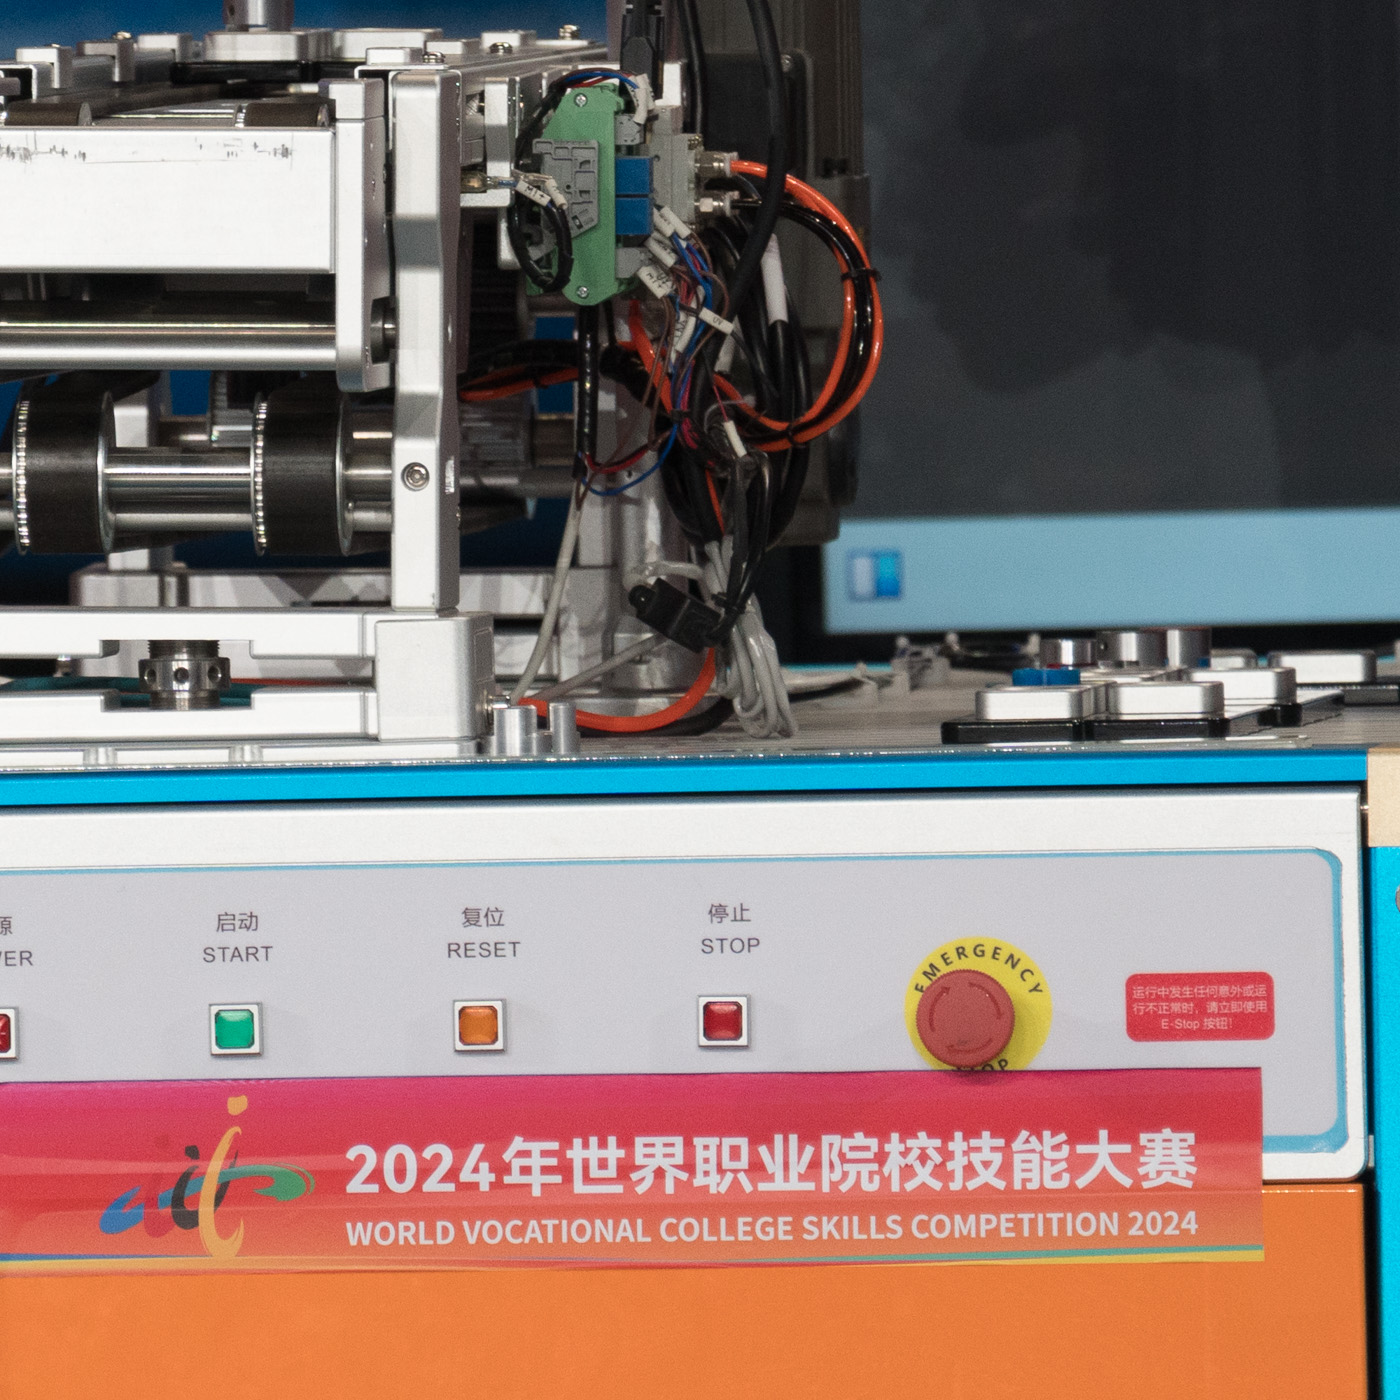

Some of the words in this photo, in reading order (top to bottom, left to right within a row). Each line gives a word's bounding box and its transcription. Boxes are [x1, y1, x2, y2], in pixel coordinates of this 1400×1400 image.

[215, 911, 260, 933] 启动
[461, 906, 505, 929] 复位
[707, 902, 752, 925] 停止
[202, 945, 274, 964] START
[446, 940, 521, 959] RESET
[701, 937, 761, 955] STOP
[1132, 984, 1268, 1000] 运行中发生任何意外或运
[1161, 1018, 1200, 1030] E-Stop
[345, 1128, 1199, 1197] 2024年世界职业院校技能大赛
[345, 1220, 456, 1246] WORLD
[462, 1218, 652, 1245] VOCATIONAL
[659, 1216, 794, 1243] COLLEGE
[802, 1214, 903, 1241] SKILLS
[911, 1211, 1120, 1239] COMPETITION
[1127, 1210, 1199, 1237] 2024
